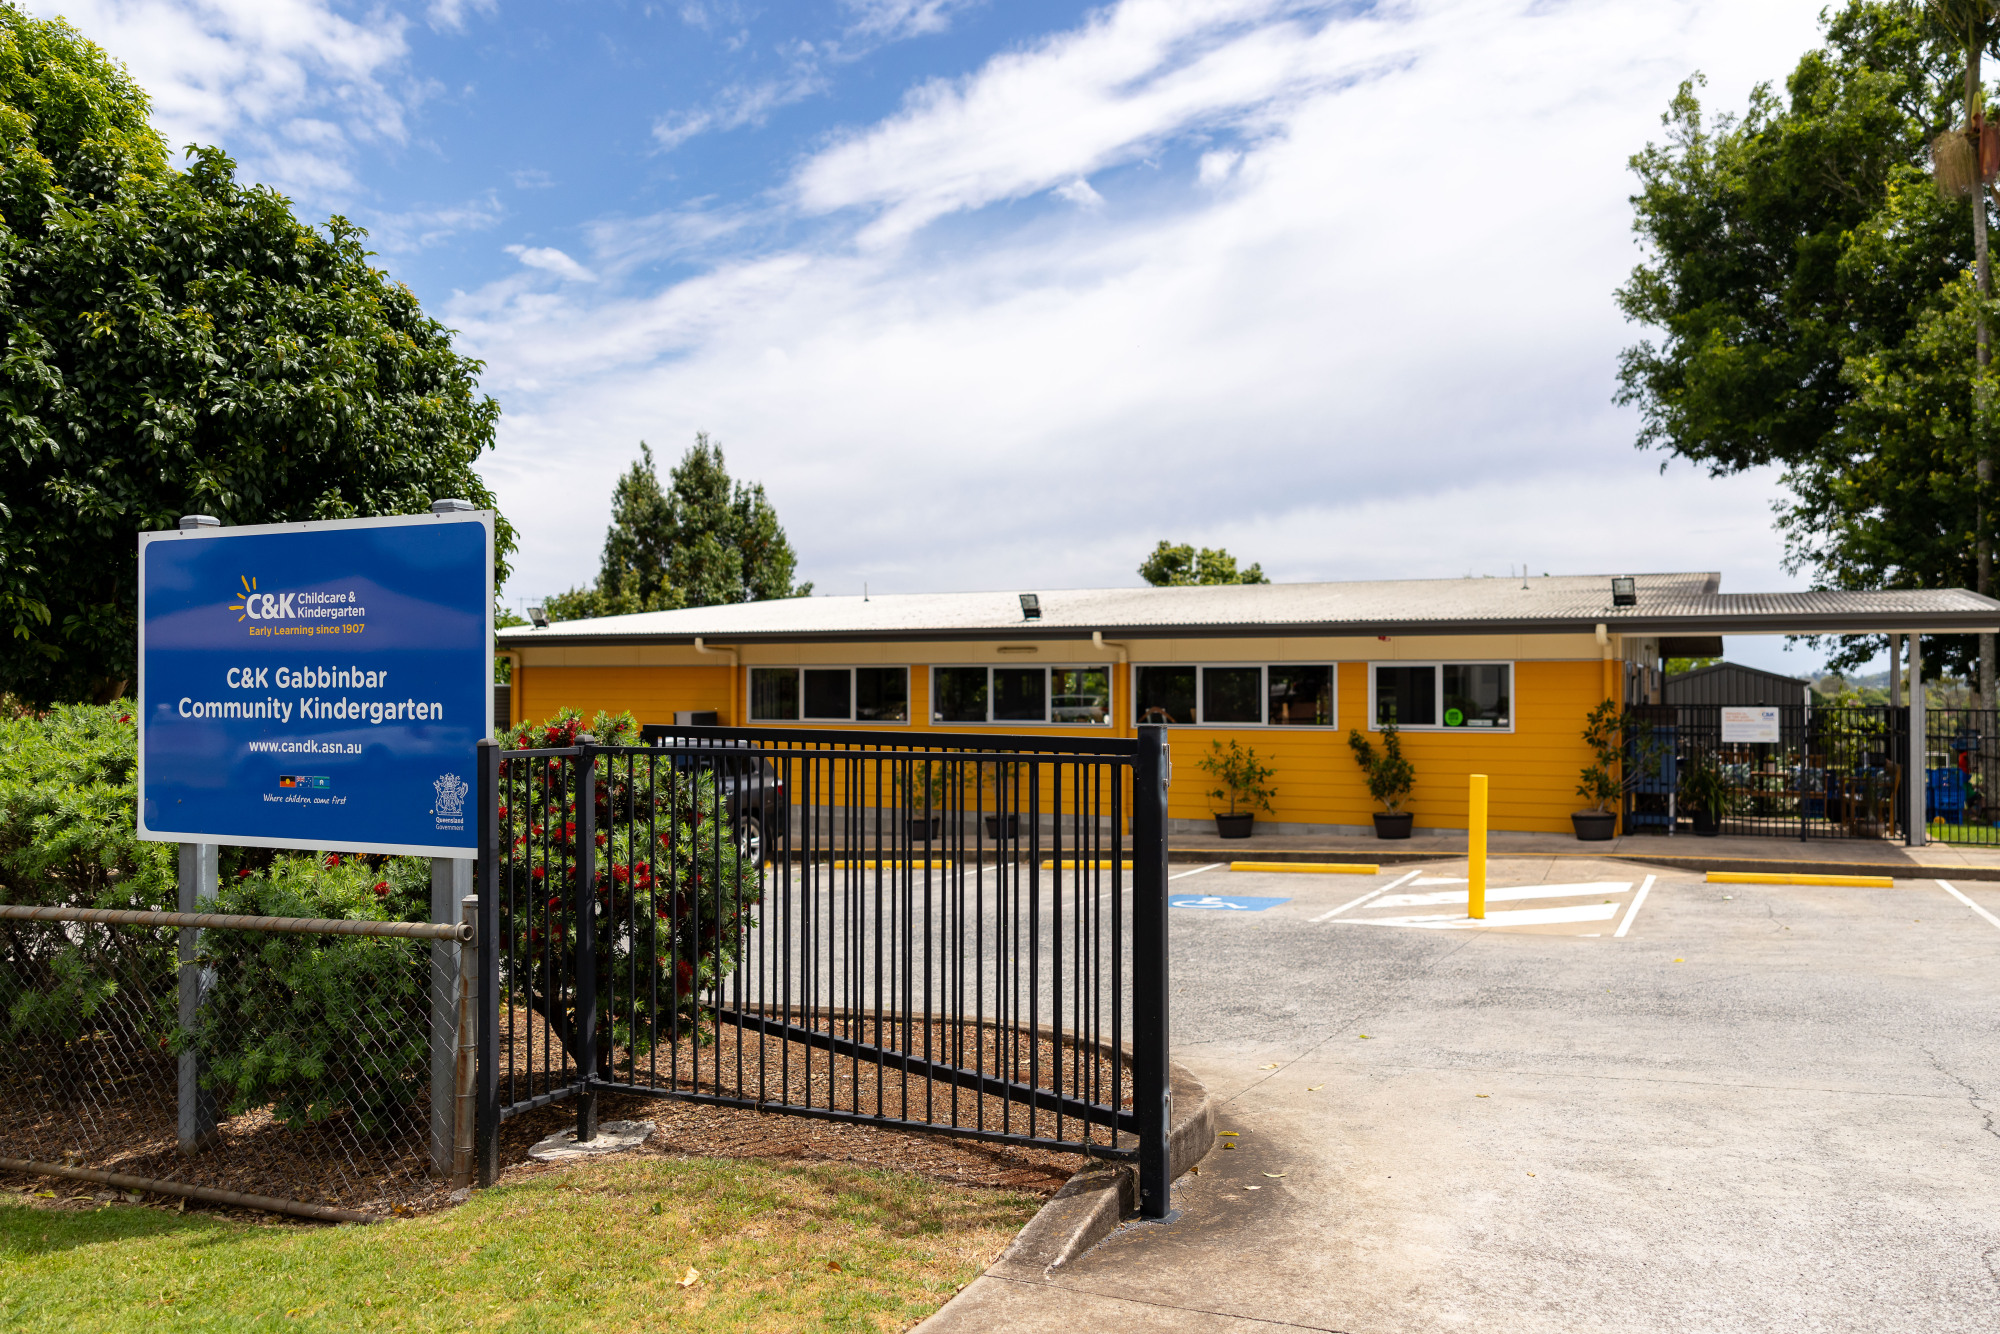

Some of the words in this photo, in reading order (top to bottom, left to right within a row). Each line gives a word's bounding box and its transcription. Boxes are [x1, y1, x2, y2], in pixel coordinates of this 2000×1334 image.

[297, 592, 346, 604] Childcare
[348, 591, 356, 602] &
[246, 593, 296, 619] C&K
[297, 606, 365, 619] Kindergarten
[249, 626, 272, 637] Early
[274, 625, 314, 636] Learning
[316, 625, 340, 634] since
[342, 624, 365, 633] 1907
[226, 667, 269, 688] C&K
[275, 665, 387, 689] Gabbinbar
[178, 697, 293, 723] Community
[299, 697, 443, 724] Kindergarten
[249, 740, 362, 754] www.candk.asn.au
[263, 793, 283, 802] Where
[285, 794, 311, 803] children
[331, 795, 347, 804] first
[435, 816, 464, 824] Queensland
